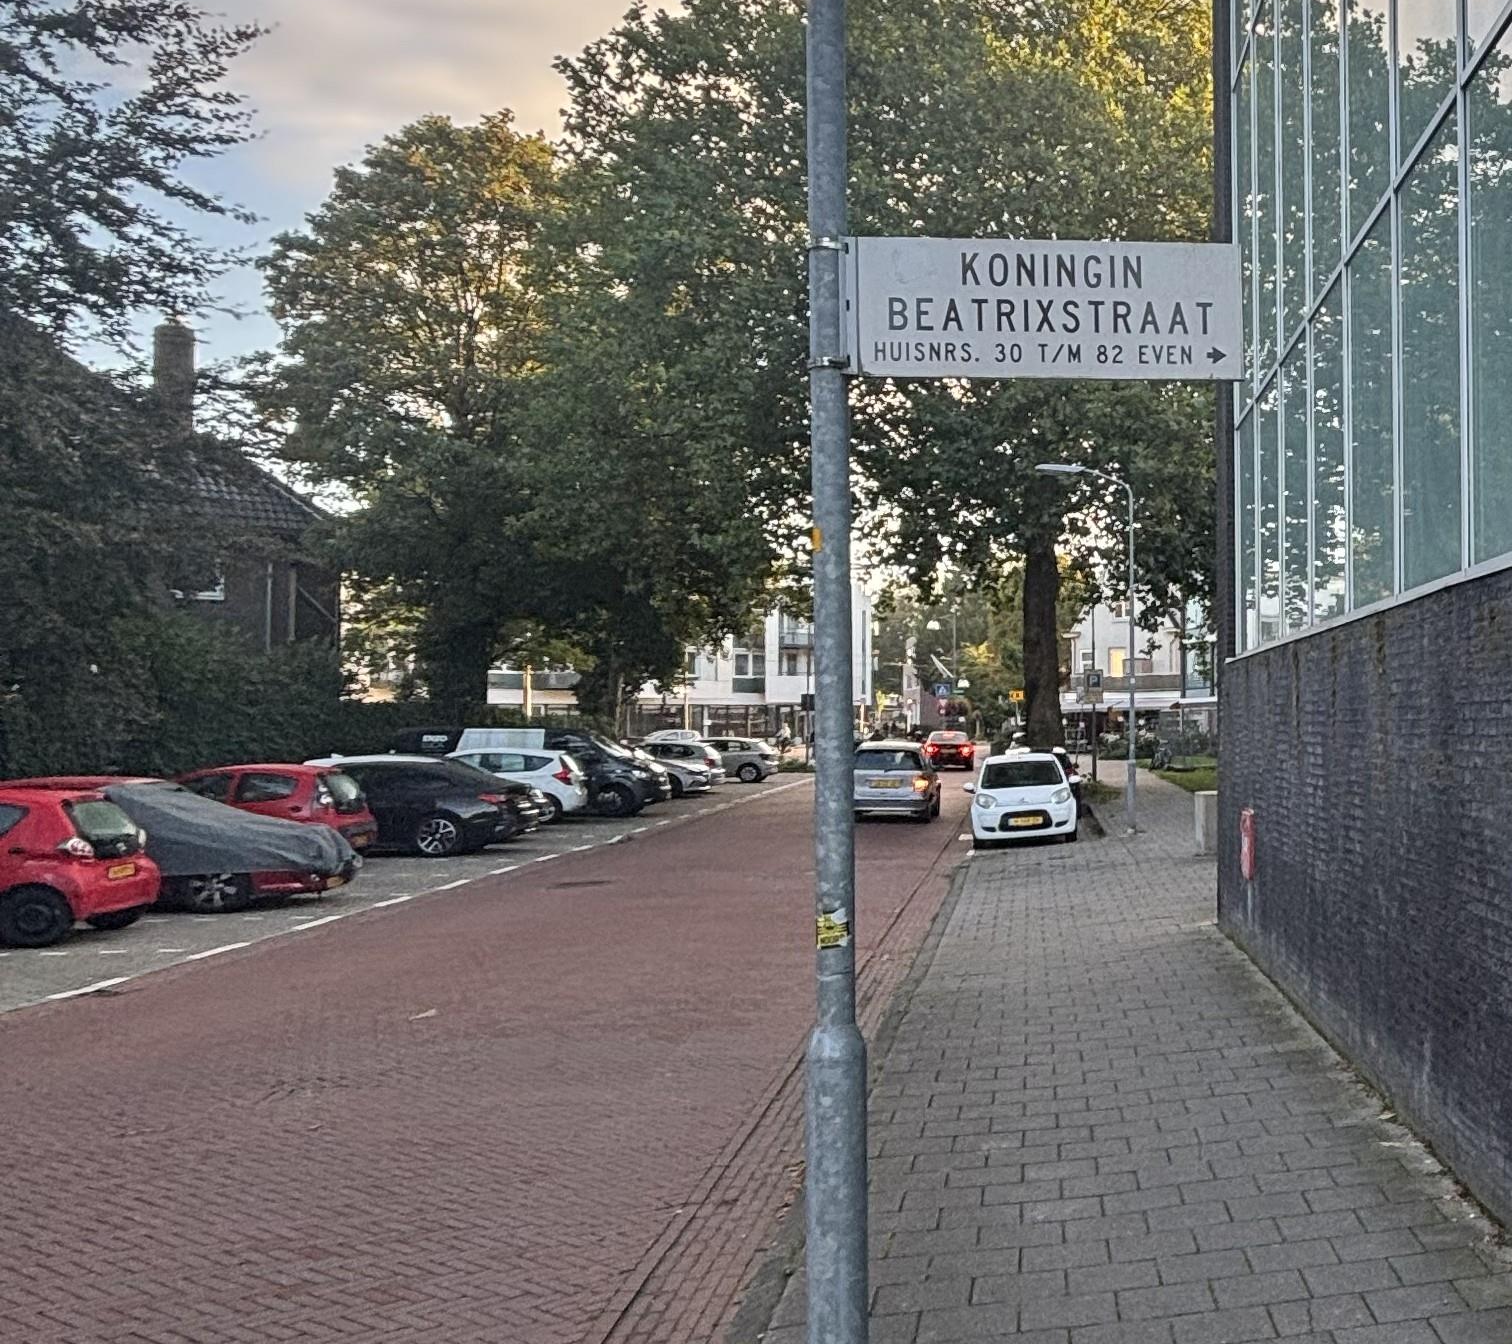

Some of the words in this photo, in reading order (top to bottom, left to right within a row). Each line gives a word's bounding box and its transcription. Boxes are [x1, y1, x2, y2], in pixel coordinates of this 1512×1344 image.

[961, 252, 1143, 289] KONINGIN
[888, 297, 1213, 335] BEATRIXSTRAAT
[874, 341, 980, 363] HUISNRS.
[994, 343, 1023, 363] 30
[1038, 343, 1082, 363] T/M
[1097, 344, 1124, 364] 82
[1138, 344, 1193, 365] EVEN
